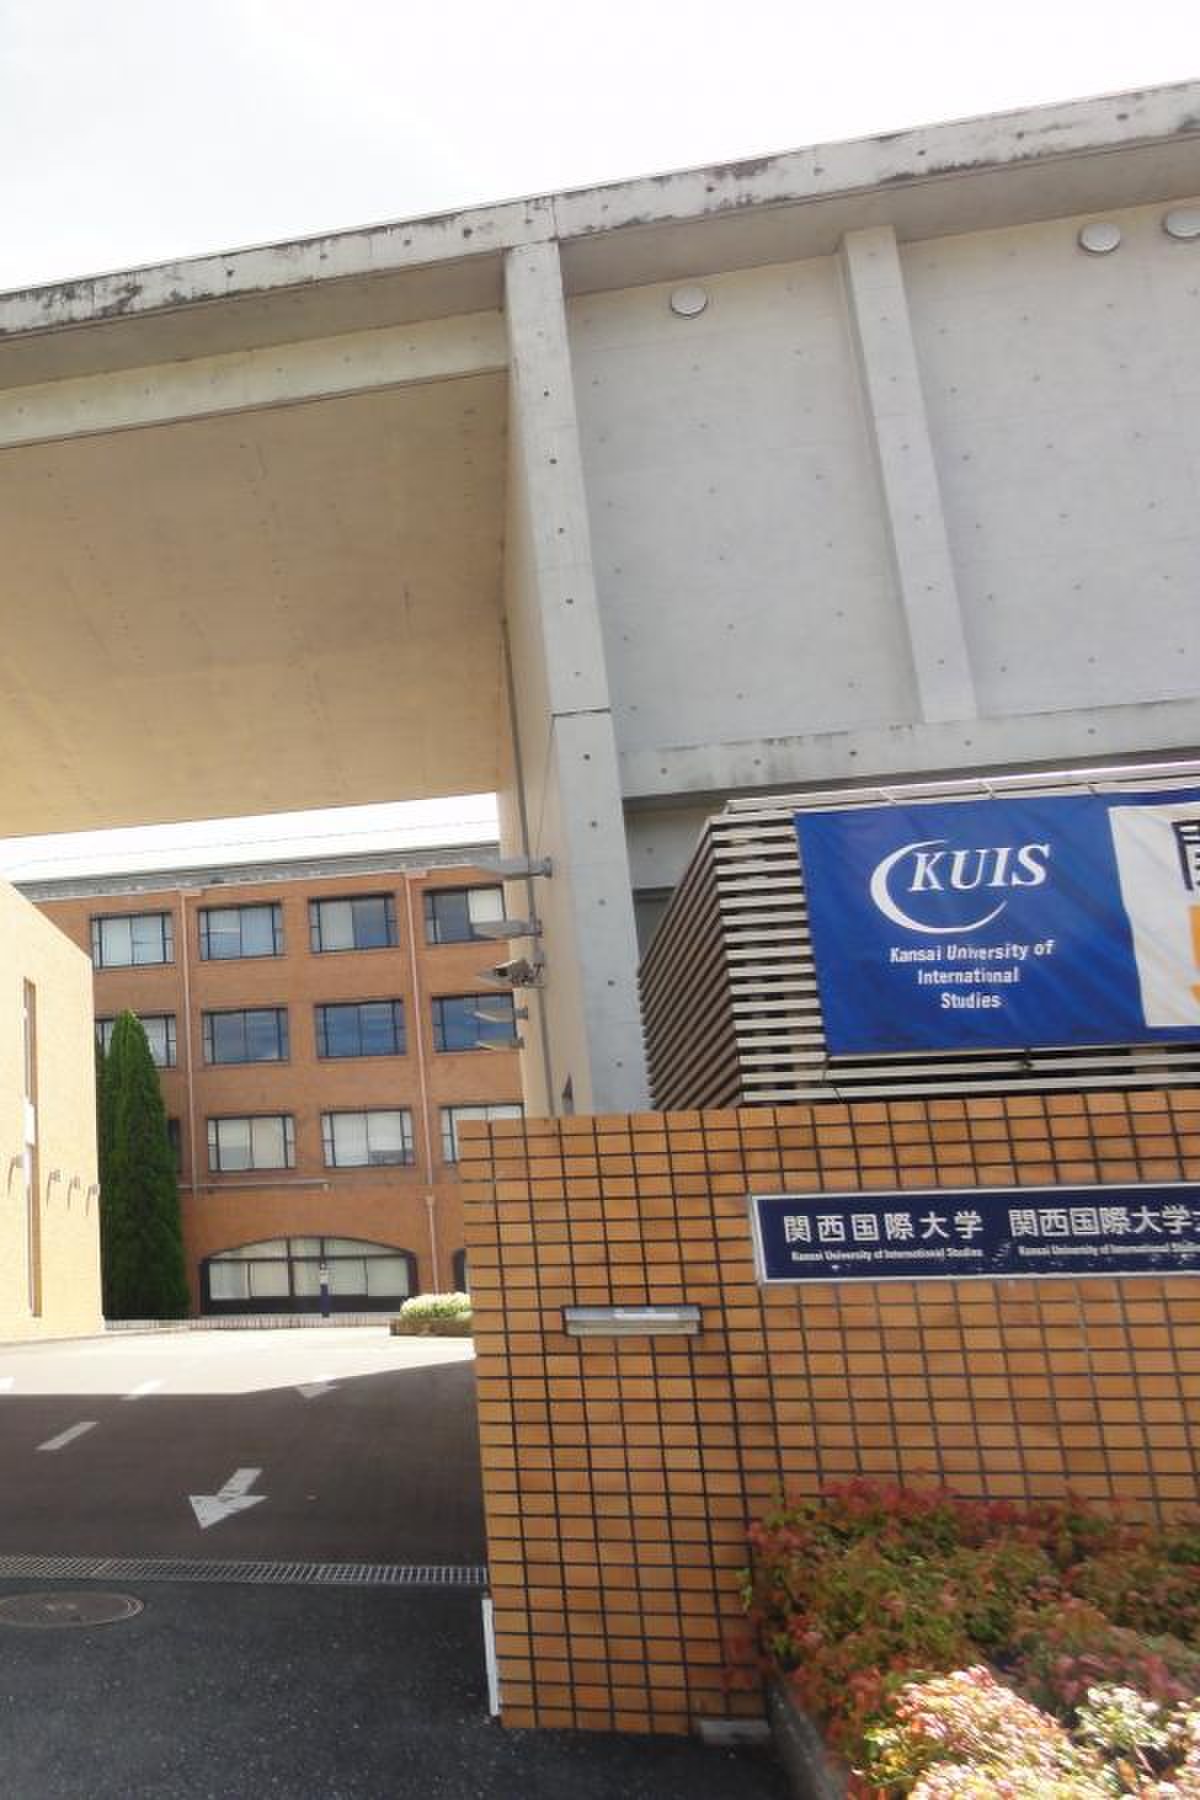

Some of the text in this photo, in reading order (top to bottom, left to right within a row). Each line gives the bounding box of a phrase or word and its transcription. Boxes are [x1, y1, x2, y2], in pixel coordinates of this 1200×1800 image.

[907, 843, 1051, 892] KUIS
[890, 939, 1055, 963] Kansai University of
[917, 966, 1020, 985] International
[941, 992, 1002, 1009] Studies
[783, 1210, 984, 1244] 関西国際大学
[823, 1249, 872, 1262] University
